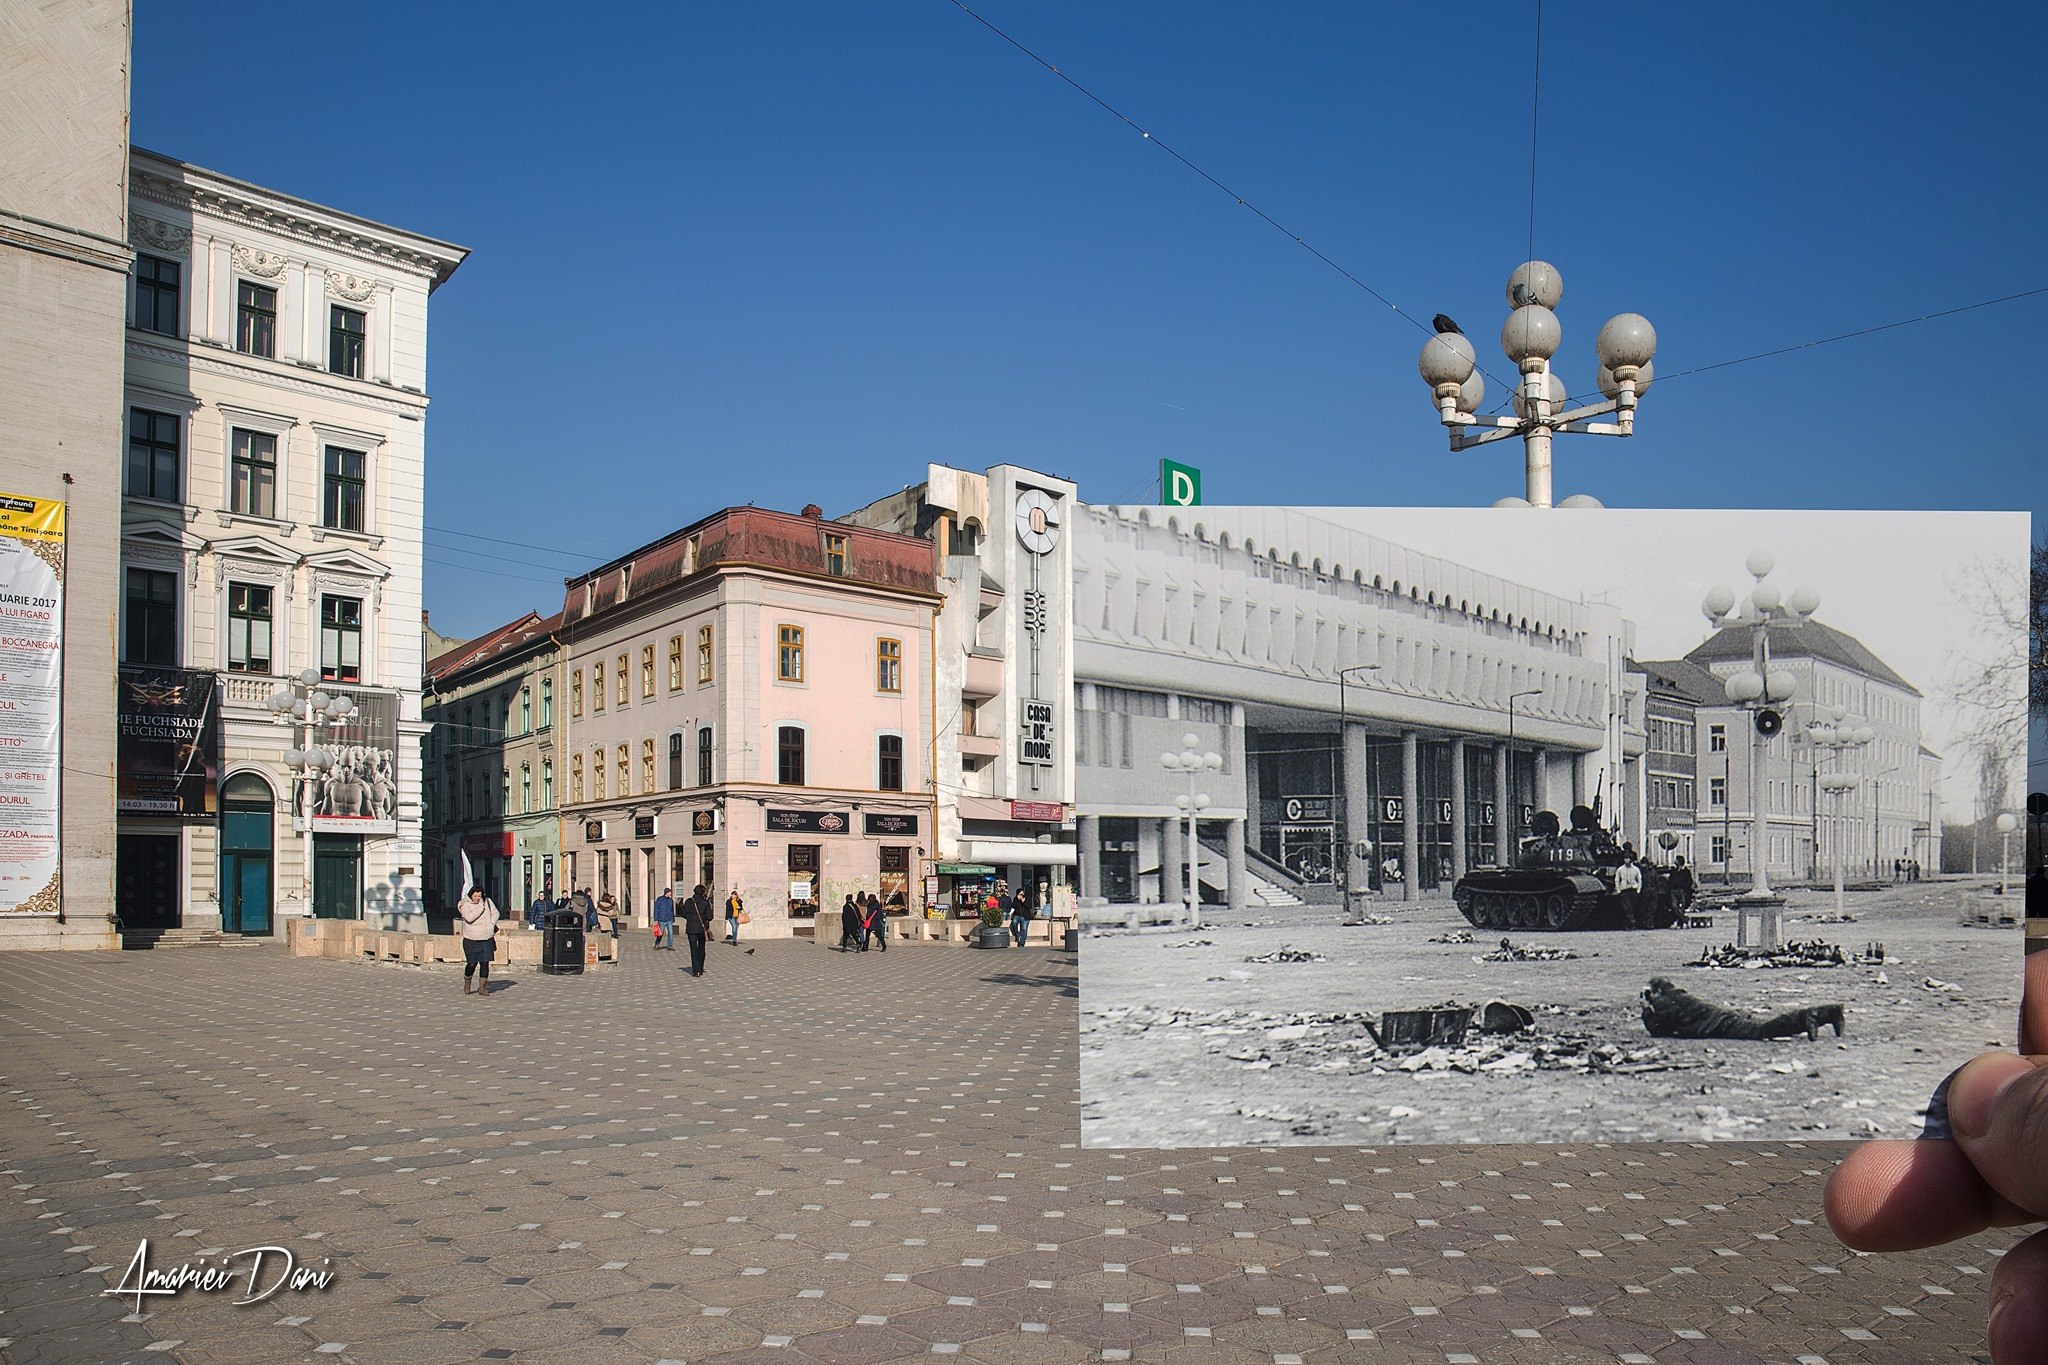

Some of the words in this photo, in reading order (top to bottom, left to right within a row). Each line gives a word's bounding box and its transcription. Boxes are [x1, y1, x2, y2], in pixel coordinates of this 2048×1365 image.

[1172, 469, 1194, 506] D
[0, 593, 30, 606] UARIE
[32, 597, 57, 608] 2017
[5, 608, 18, 617] LUI
[20, 610, 50, 620] FIGARO
[2, 637, 60, 650] BOCCANEGRA
[1027, 704, 1051, 723] CASA
[135, 715, 205, 729] FUCHSIADE
[122, 725, 194, 739] FUCHSIADA
[1033, 723, 1045, 741] DE
[1024, 741, 1051, 760] MODE
[15, 772, 46, 781] GRETEL
[1550, 848, 1573, 861] 119
